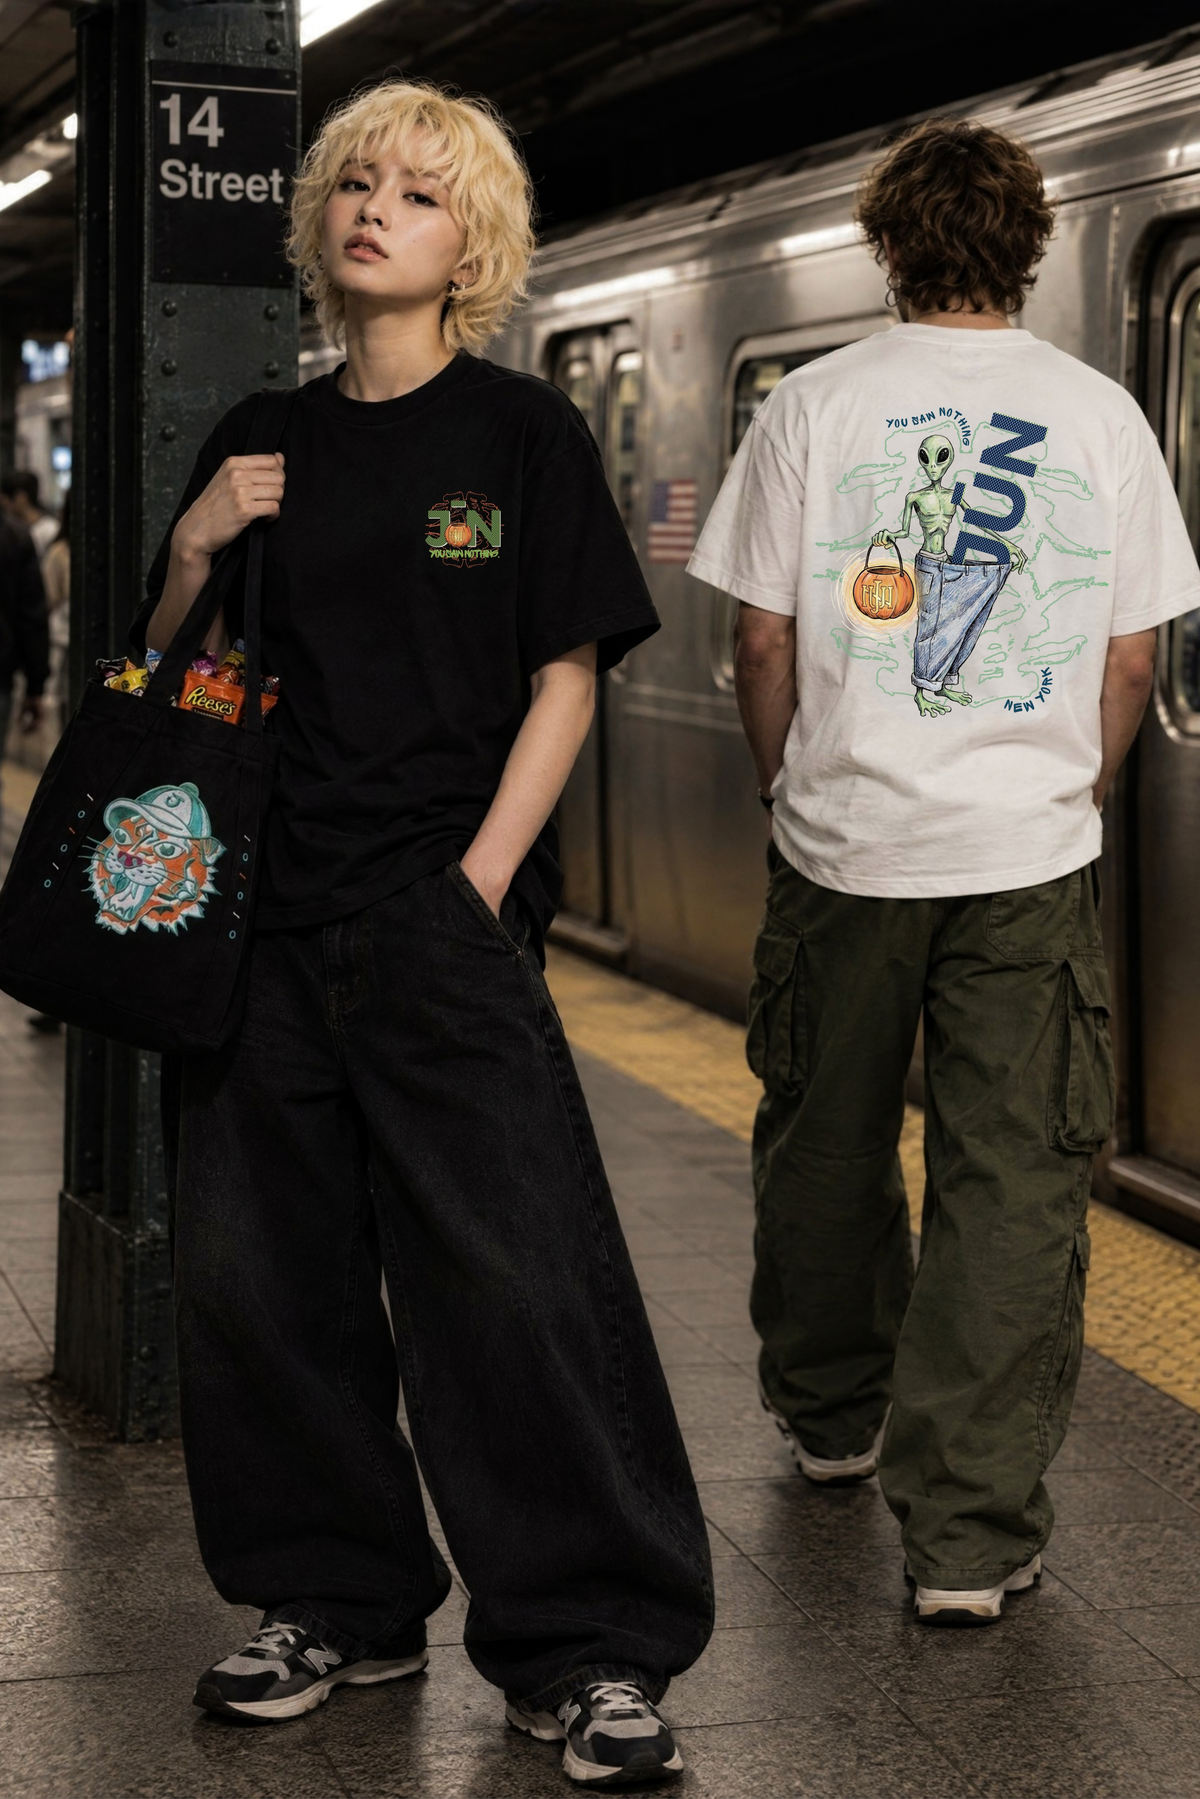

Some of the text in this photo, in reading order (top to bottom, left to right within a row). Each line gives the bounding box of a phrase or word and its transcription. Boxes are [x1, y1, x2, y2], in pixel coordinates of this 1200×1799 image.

[159, 93, 225, 148] 14
[159, 158, 284, 204] Street
[886, 418, 908, 428] YOU
[1003, 667, 1053, 713] NEW YORK
